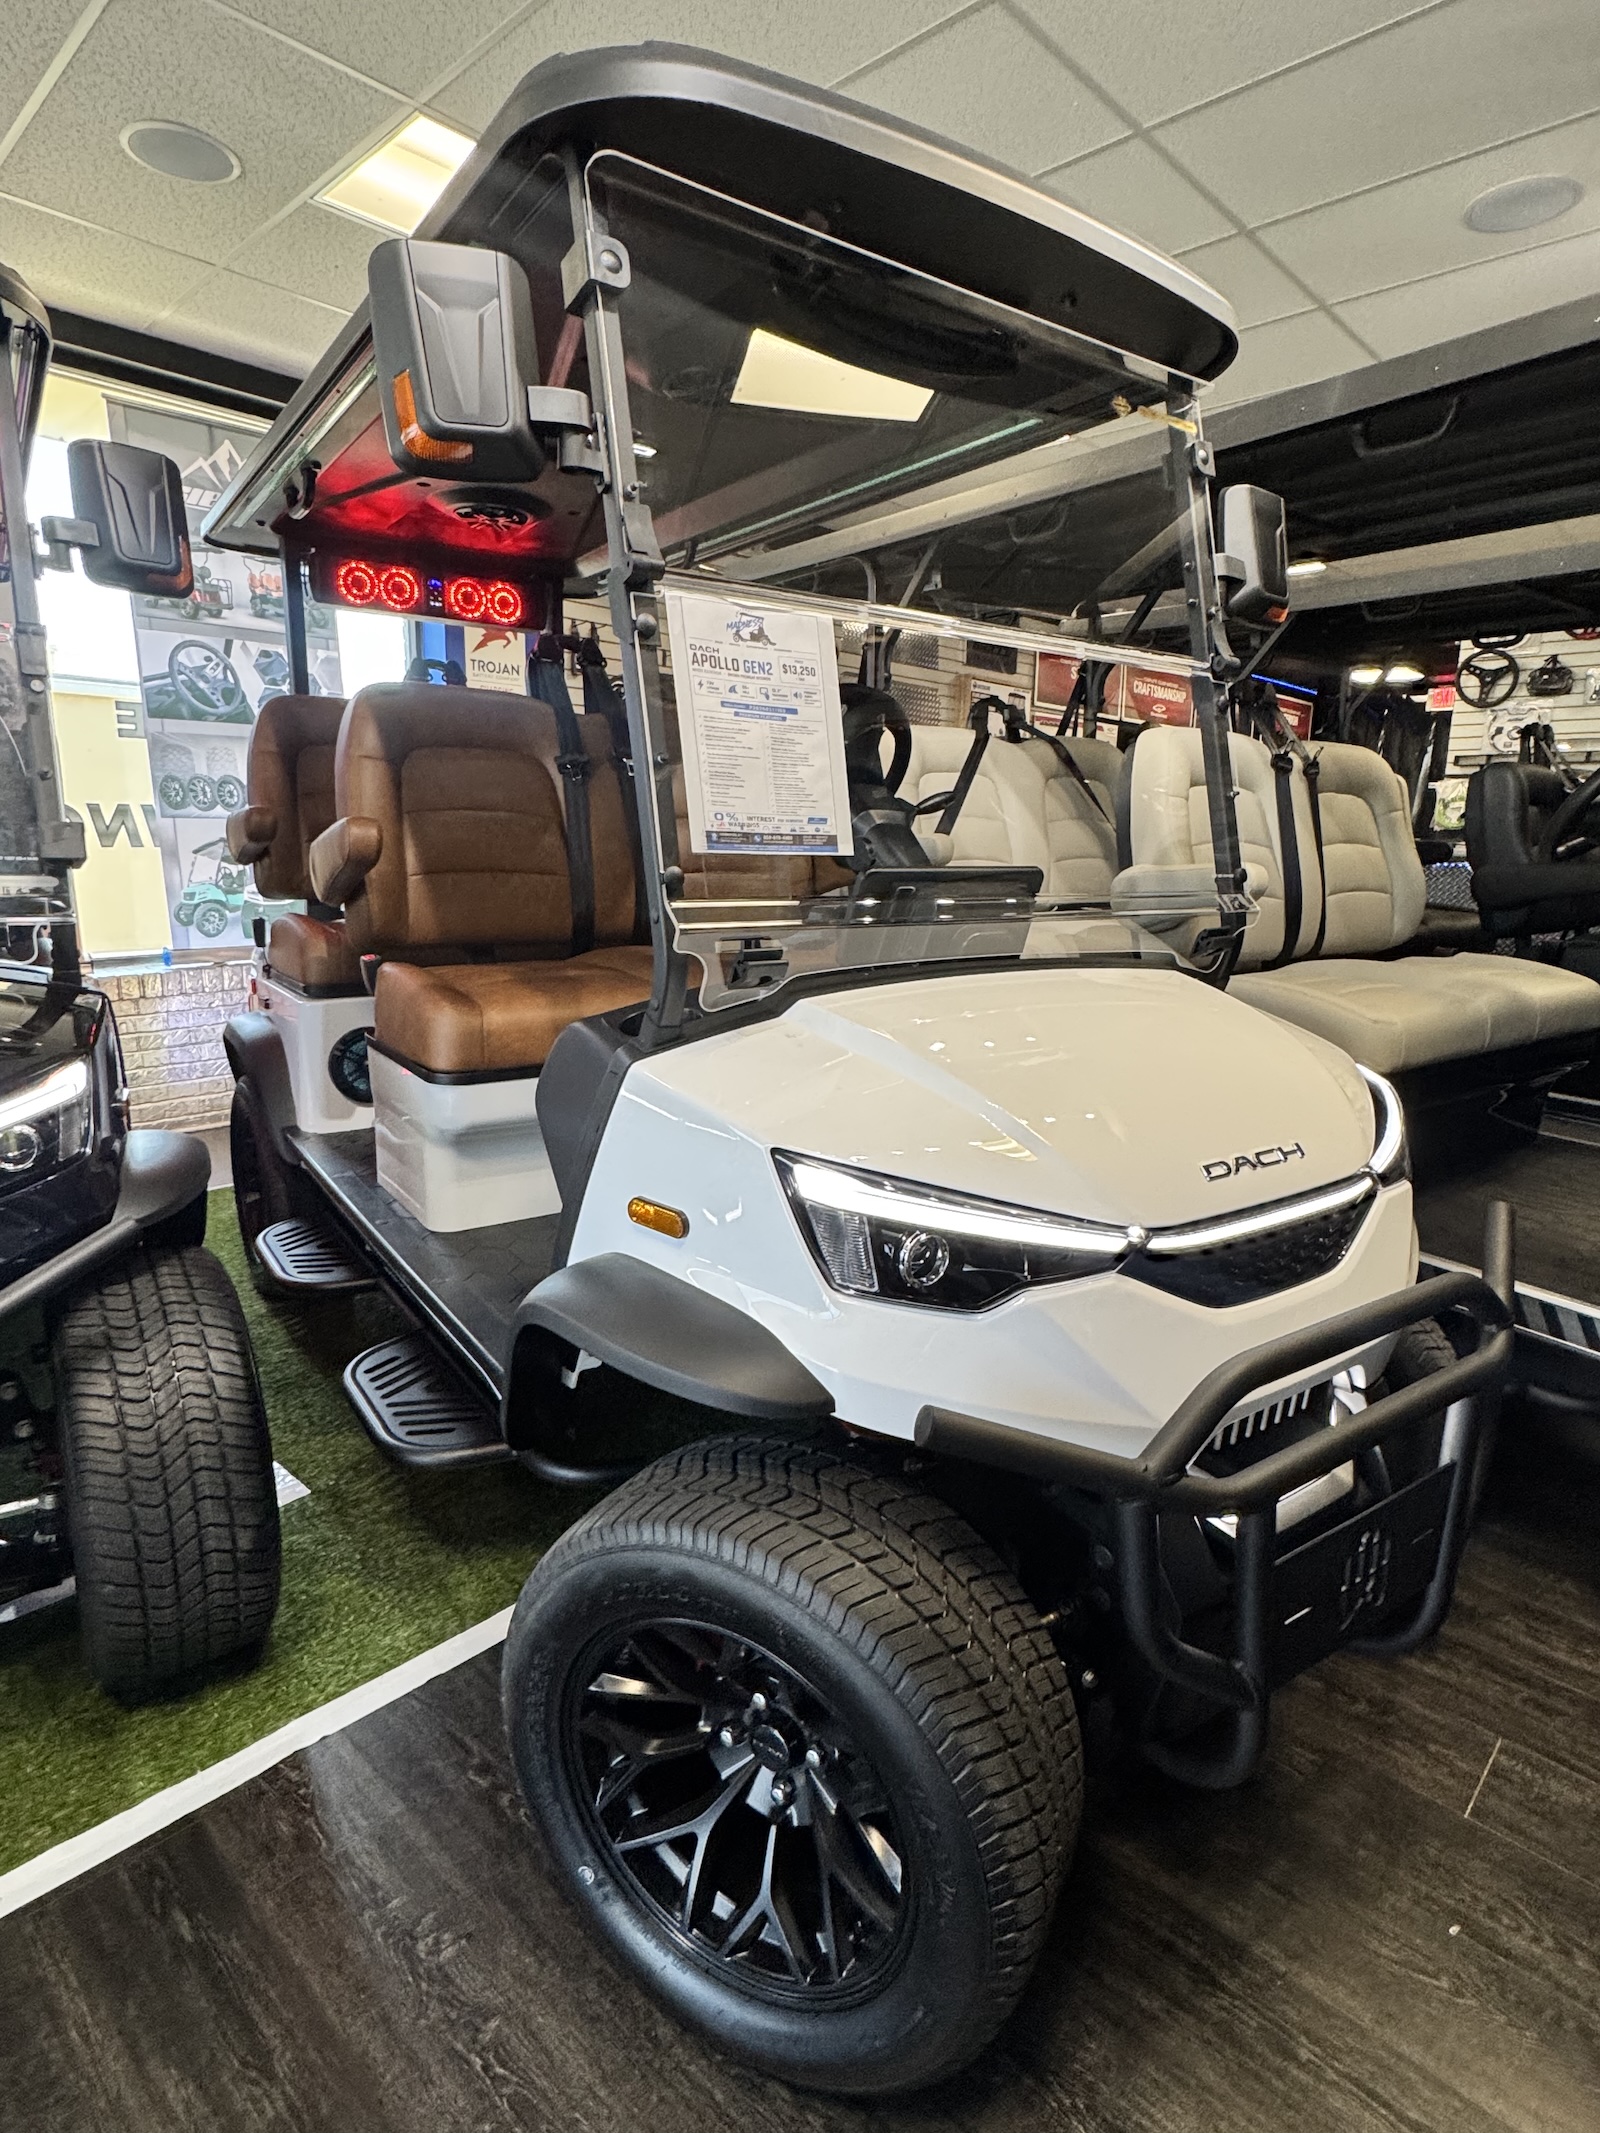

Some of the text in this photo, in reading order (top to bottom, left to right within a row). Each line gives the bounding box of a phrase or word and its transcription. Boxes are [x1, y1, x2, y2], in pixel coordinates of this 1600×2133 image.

[689, 643, 720, 654] DACH
[470, 658, 520, 676] TROJAN
[691, 652, 740, 672] APOLLO
[743, 659, 773, 676] GEN2
[782, 664, 816, 678] $13,250
[1133, 680, 1187, 704] CRAFTSMANSHIP
[746, 815, 775, 823] INTEREST
[1200, 1142, 1305, 1182] DACH
